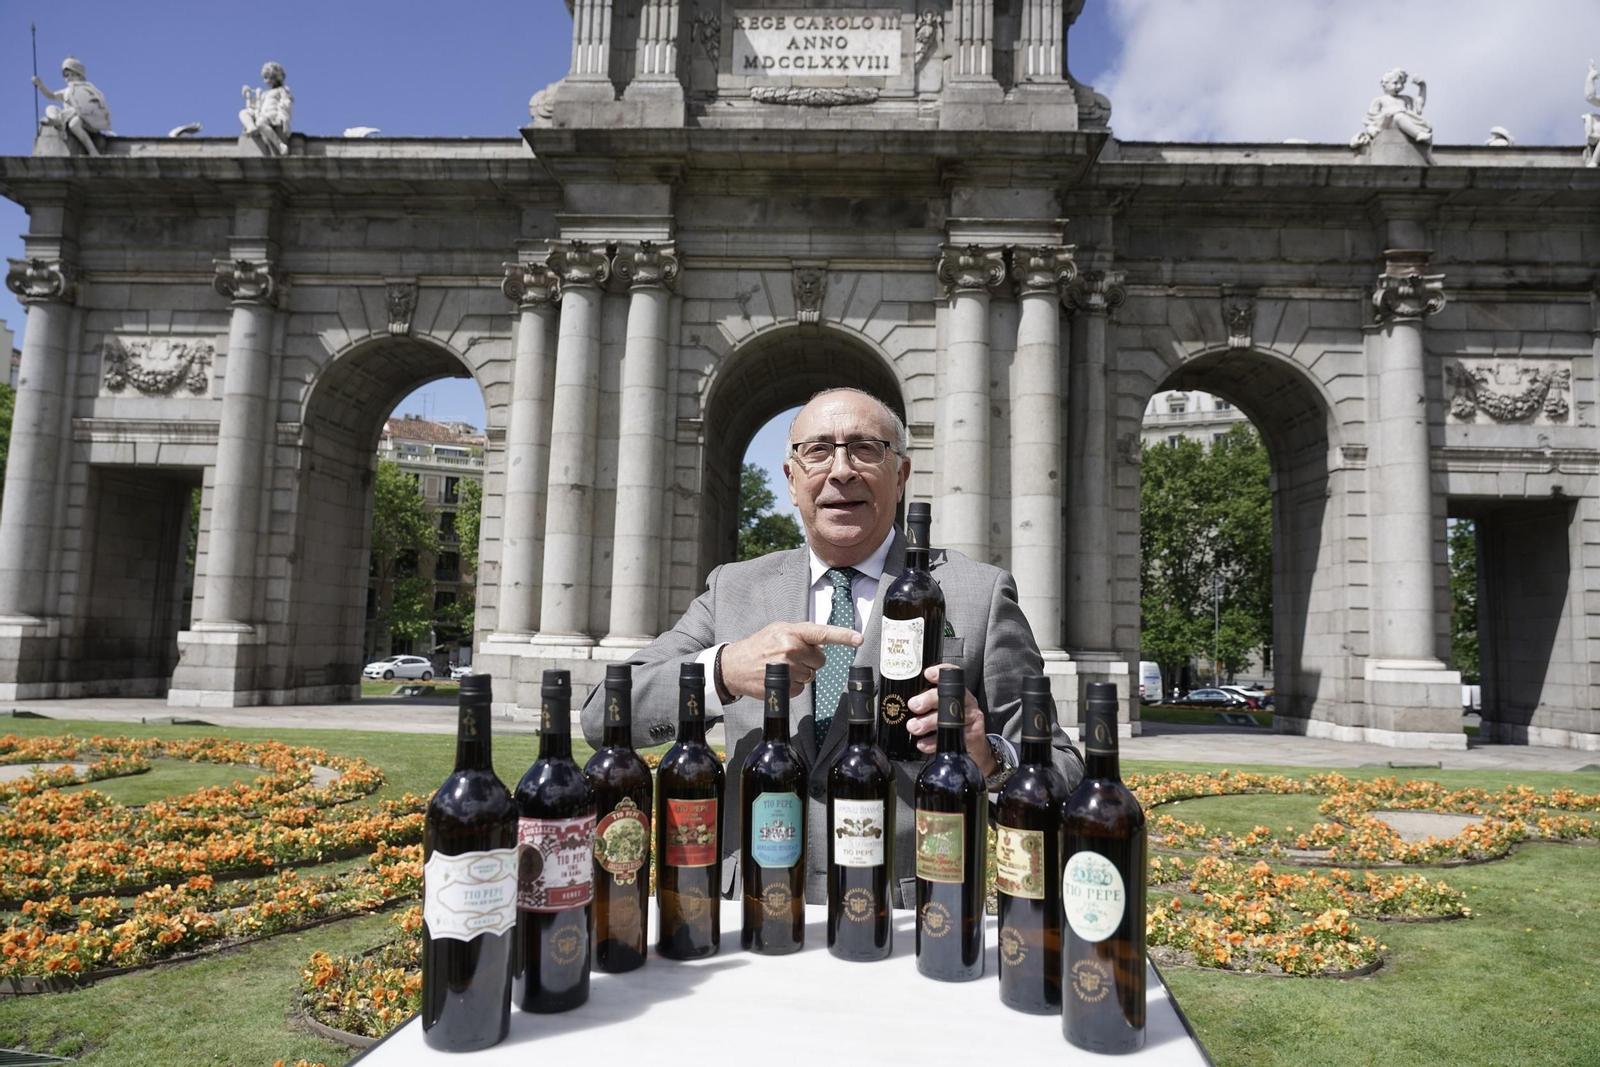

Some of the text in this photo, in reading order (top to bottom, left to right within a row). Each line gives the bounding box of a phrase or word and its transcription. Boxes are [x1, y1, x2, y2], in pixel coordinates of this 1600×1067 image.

[734, 17, 901, 30] REGE CAROLO III
[787, 36, 848, 50] ANNO
[744, 55, 889, 69] MDCCLXXVIII
[691, 804, 709, 812] PEPE
[763, 799, 793, 809] TIO PEPE
[611, 810, 639, 820] TIO PEPE
[557, 851, 586, 866] TIO PEPE
[843, 848, 874, 857] TIO PEPE
[463, 886, 503, 900] TIO PEPE
[1064, 882, 1122, 902] TIO PEPE
